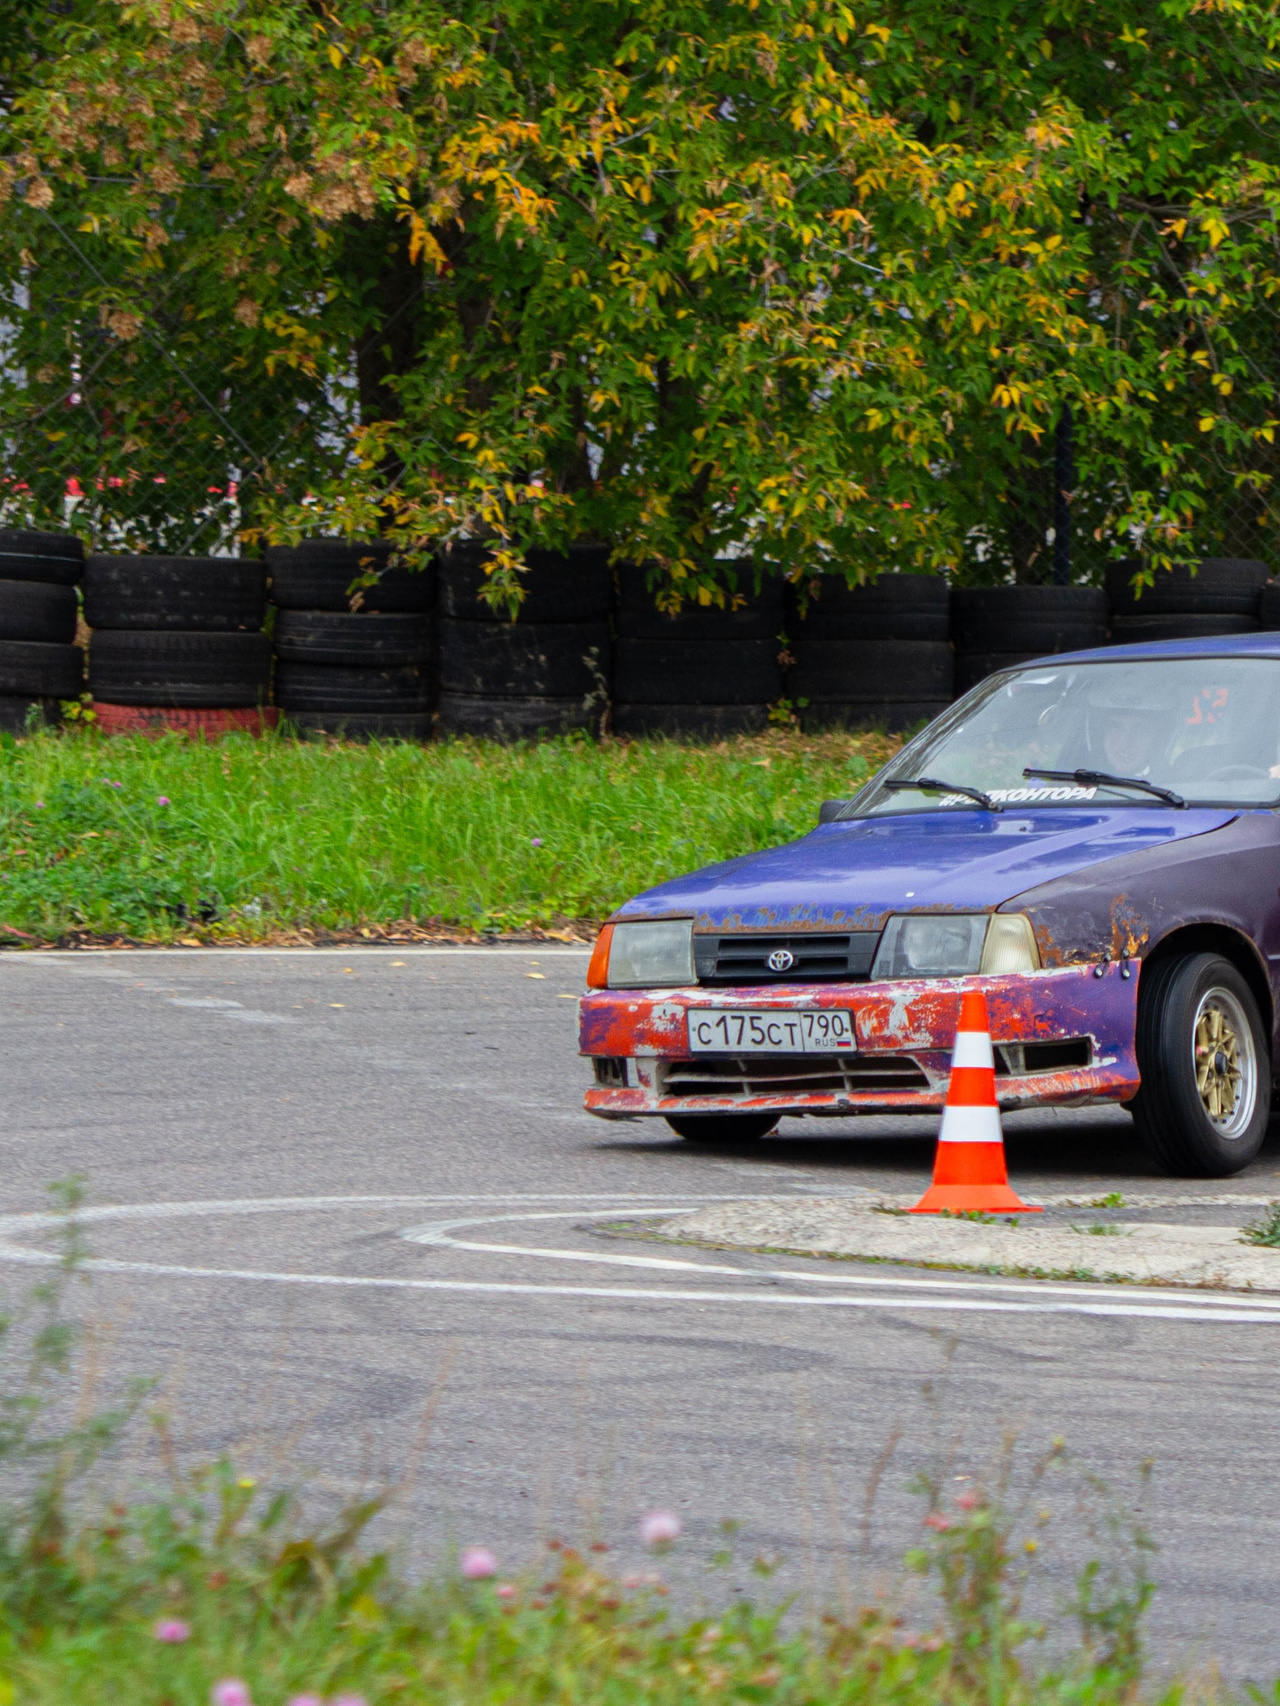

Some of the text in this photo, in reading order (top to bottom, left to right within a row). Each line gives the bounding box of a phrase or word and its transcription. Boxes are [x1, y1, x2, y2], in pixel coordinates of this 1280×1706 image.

[938, 786, 1098, 807] #РКОНТОРА
[803, 1014, 844, 1038] 790
[815, 1037, 836, 1048] RUS
